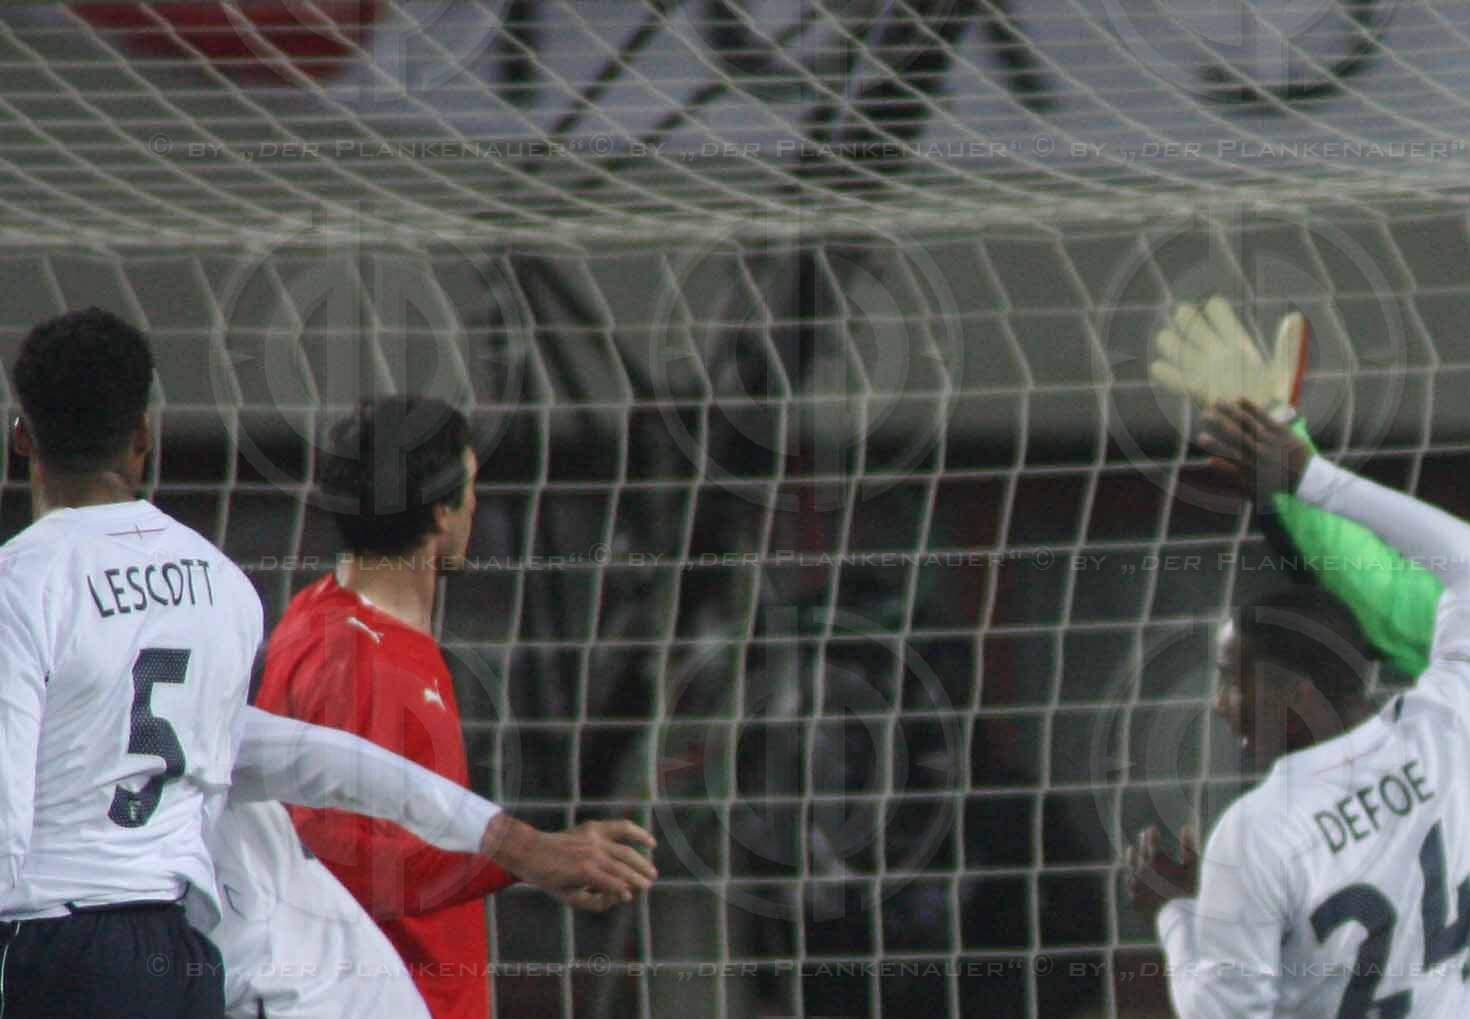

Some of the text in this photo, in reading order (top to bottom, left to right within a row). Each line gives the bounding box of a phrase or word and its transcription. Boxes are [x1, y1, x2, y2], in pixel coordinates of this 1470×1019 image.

[86, 558, 214, 618] LESCOTT
[107, 647, 192, 828] 5
[1313, 760, 1435, 855] DEFOE
